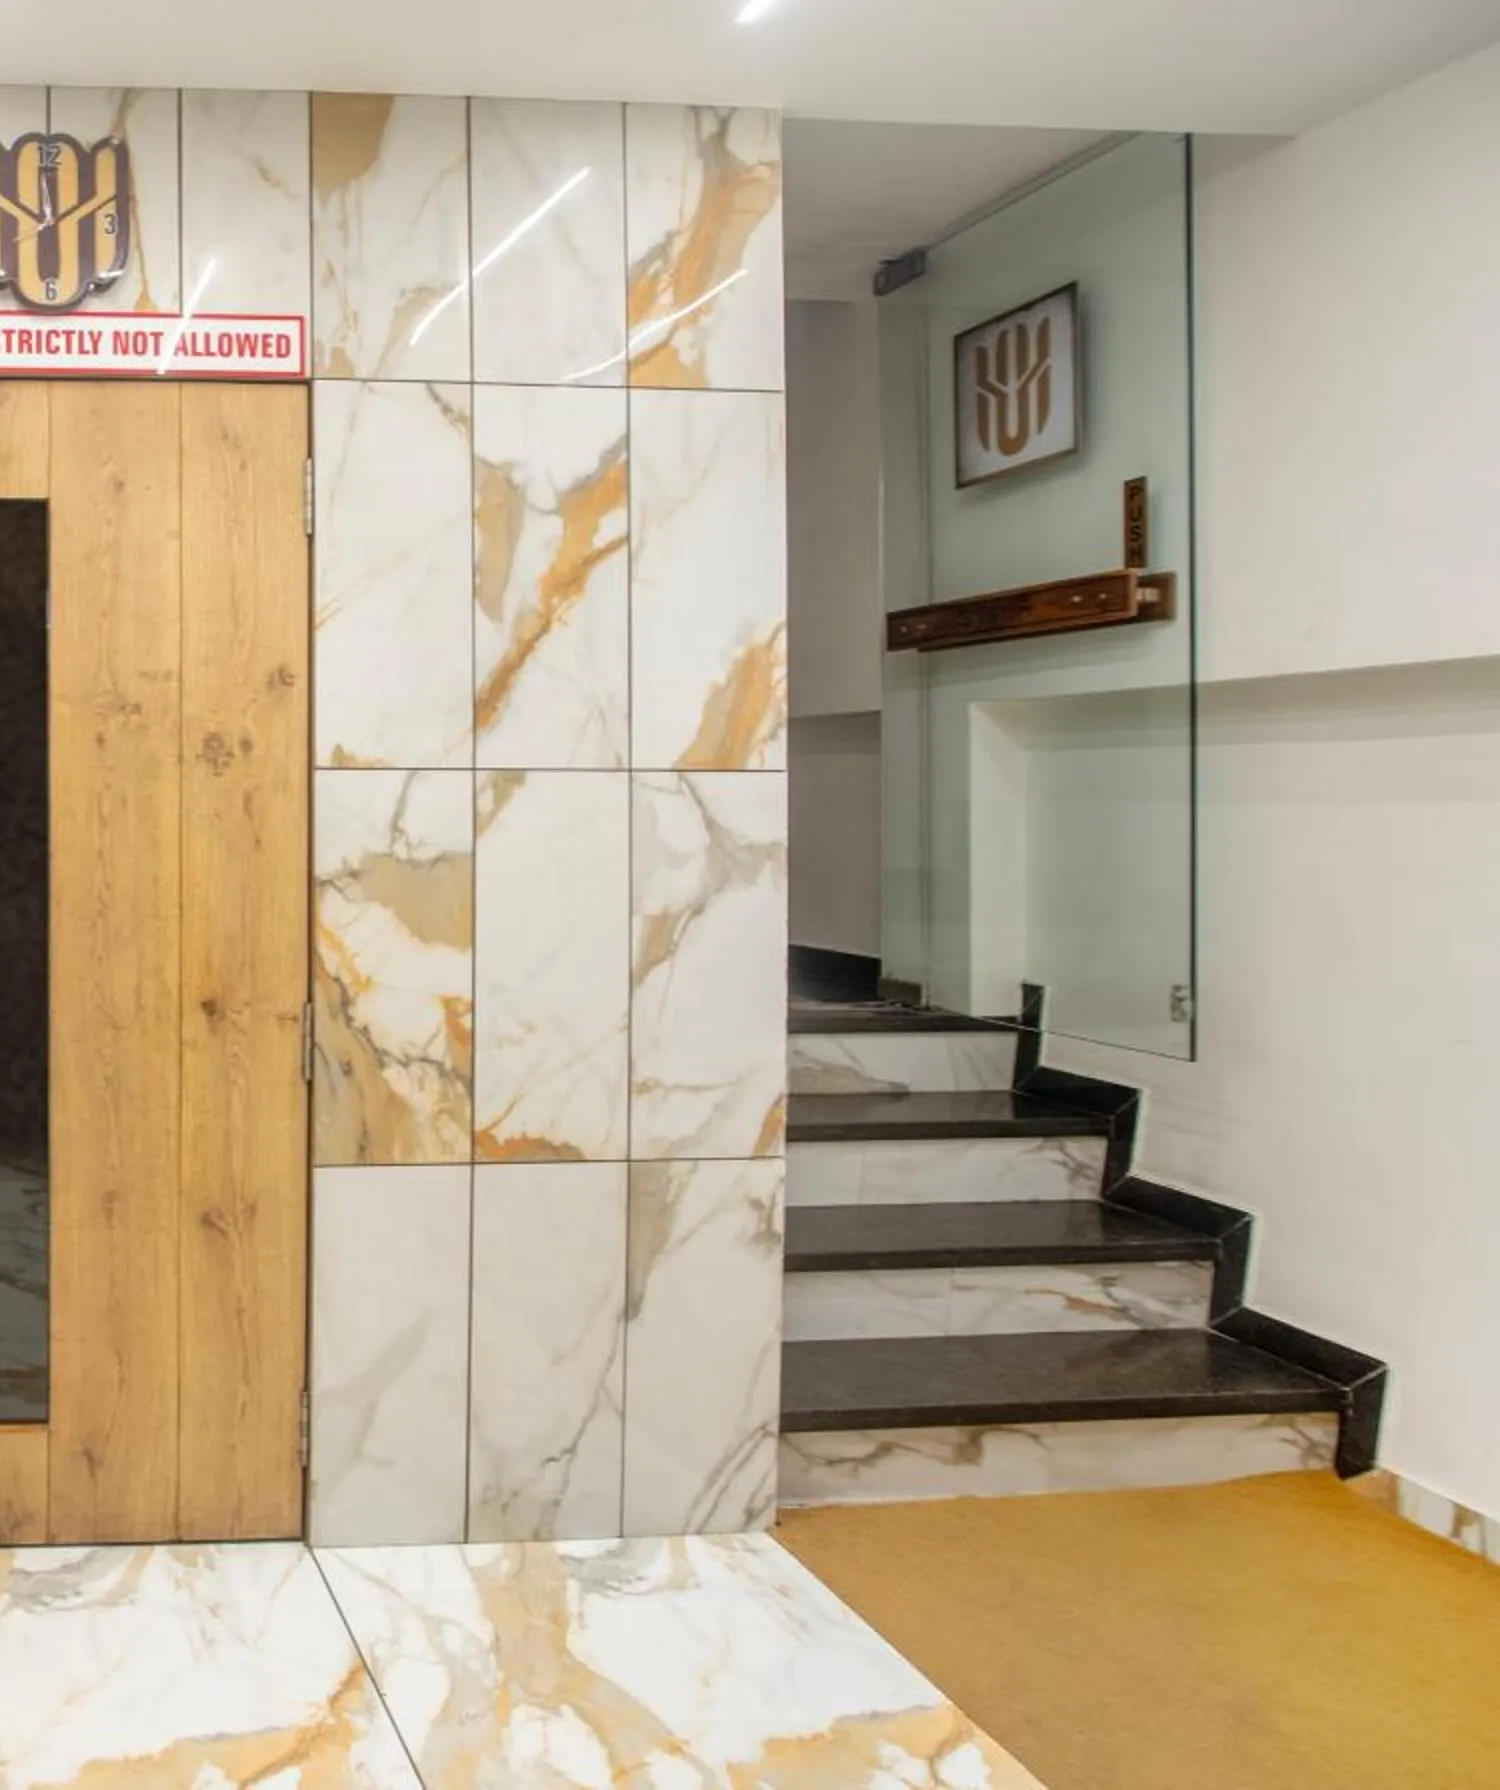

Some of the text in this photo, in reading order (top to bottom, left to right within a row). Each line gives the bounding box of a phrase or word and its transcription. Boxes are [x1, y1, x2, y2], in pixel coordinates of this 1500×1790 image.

[37, 145, 63, 168] 12
[103, 213, 118, 235] 3
[45, 279, 58, 301] 6
[112, 331, 165, 356] NOT
[173, 332, 291, 358] ALLOWED
[1128, 484, 1144, 563] PUSH
